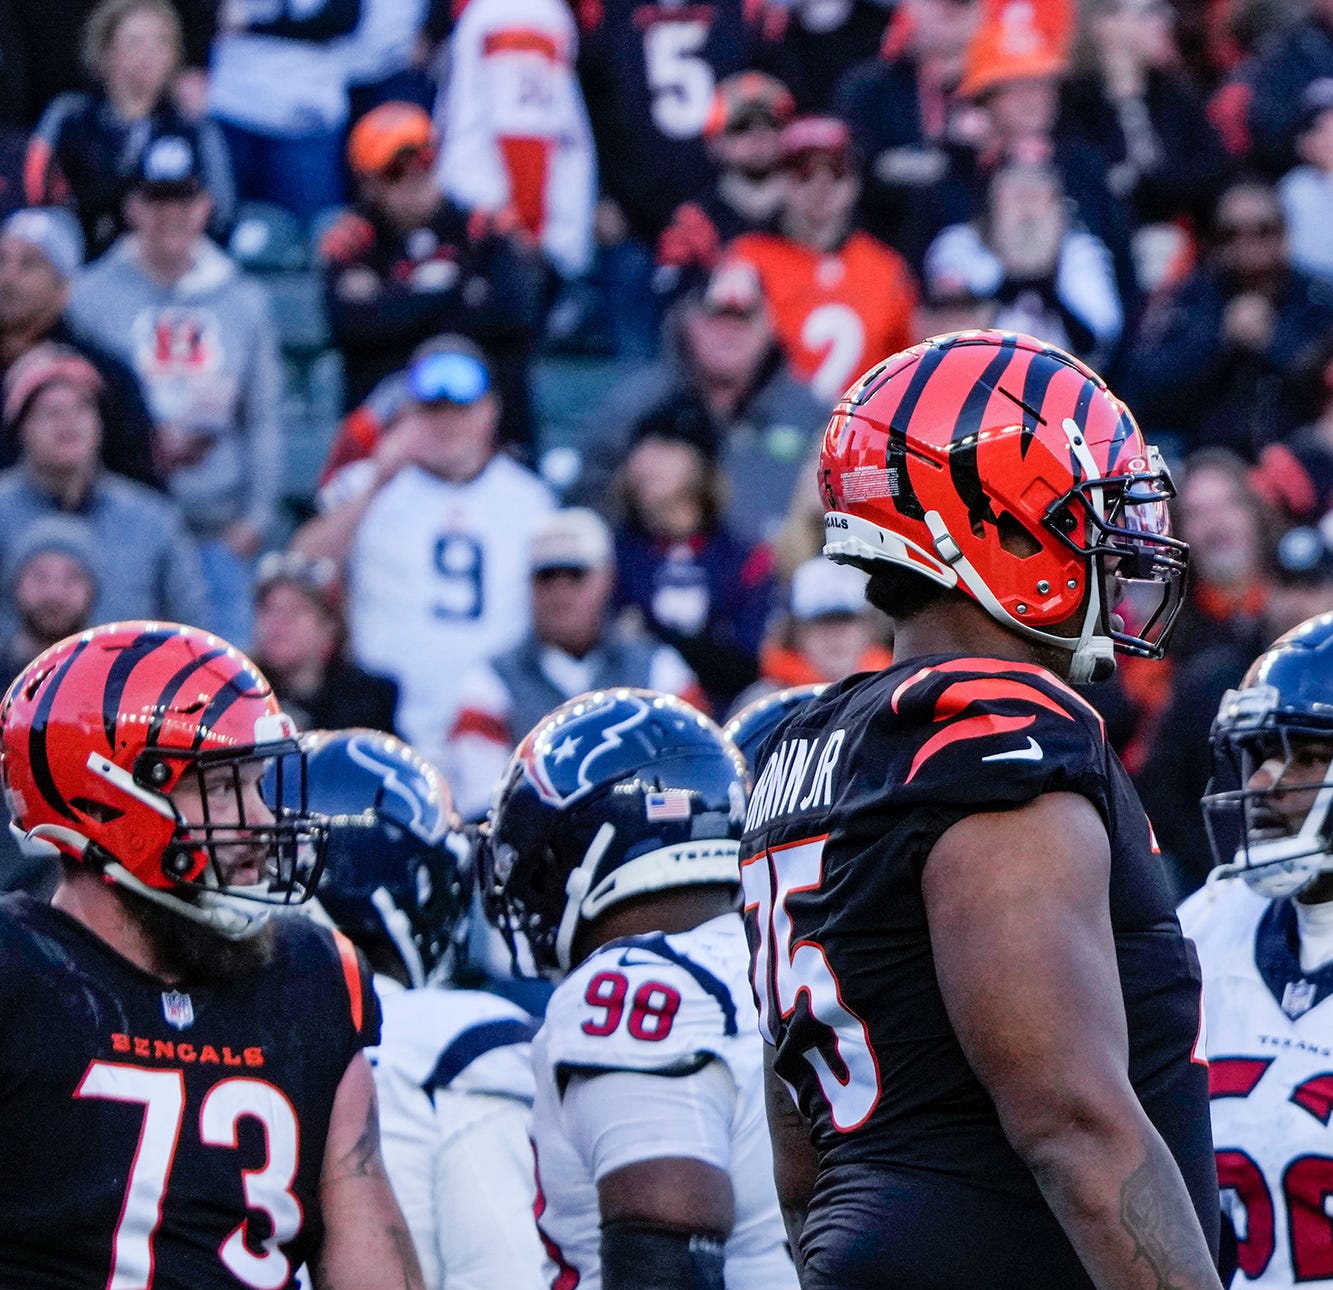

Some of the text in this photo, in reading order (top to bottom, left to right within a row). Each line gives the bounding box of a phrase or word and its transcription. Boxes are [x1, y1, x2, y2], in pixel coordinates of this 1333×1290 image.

[644, 21, 716, 140] 5
[433, 533, 484, 620] 9
[580, 971, 681, 1042] 98
[740, 833, 882, 1133] 75
[111, 1032, 265, 1068] BENGALS
[1258, 1035, 1330, 1057] TEXANS
